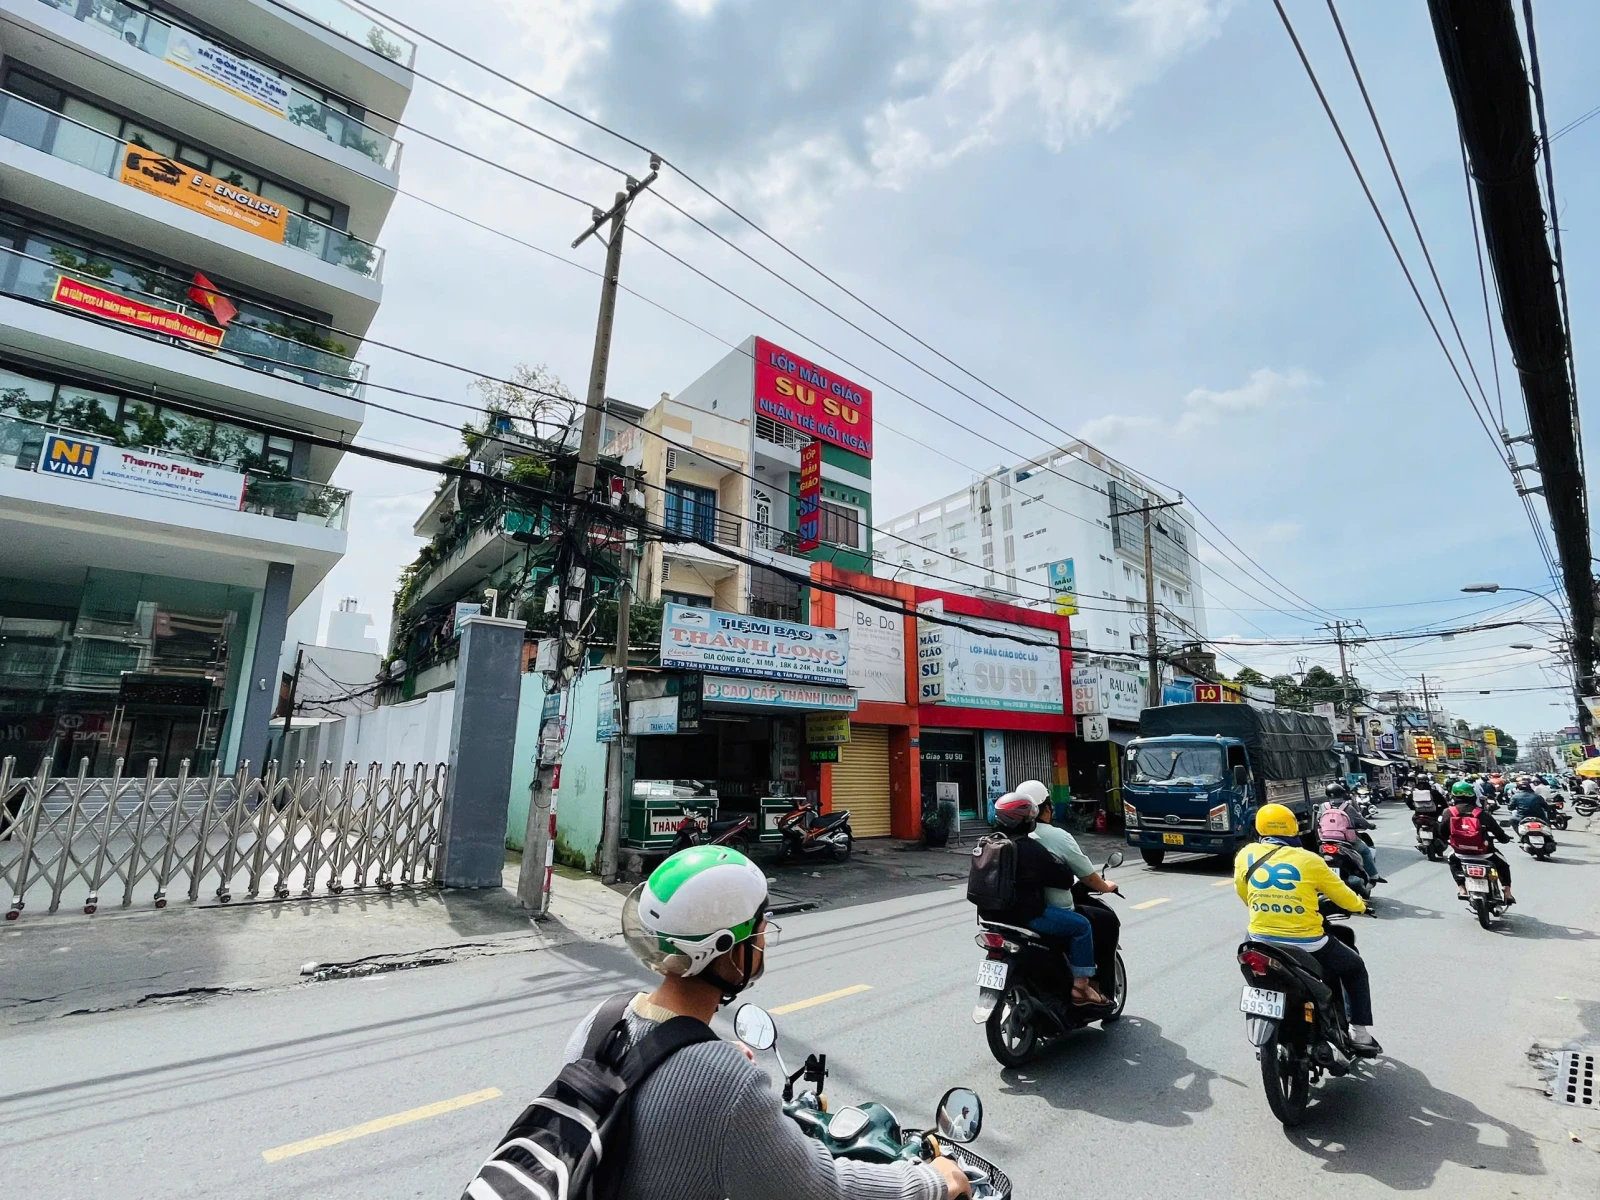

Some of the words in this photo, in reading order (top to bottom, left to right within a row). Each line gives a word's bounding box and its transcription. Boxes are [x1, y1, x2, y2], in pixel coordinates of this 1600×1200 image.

[265, 81, 288, 97] LAND
[192, 174, 203, 186] E
[214, 184, 280, 218] ENGLISH
[205, 200, 233, 216] English
[60, 286, 70, 297] AN
[771, 352, 796, 373] LỚP
[799, 365, 828, 389] MẪU
[831, 381, 862, 406] GIÁO
[775, 376, 816, 406] SU
[822, 397, 860, 425] SU
[759, 398, 794, 422] NHẬN
[796, 413, 815, 431] TRẺ
[817, 421, 840, 440] MỖI
[841, 434, 871, 453] NGÀY
[51, 439, 94, 466] Ni
[802, 448, 816, 462] LỚP
[49, 460, 89, 477] VINA
[122, 454, 168, 471] Thermo
[171, 464, 204, 478] Fisher
[102, 470, 146, 482] LABORATORY
[121, 464, 201, 485] SCIENTIFIC
[800, 475, 818, 492] GIÁO
[799, 494, 818, 516] SU
[799, 520, 818, 542] SU
[1055, 577, 1072, 586] MẪU
[718, 616, 770, 634] TIỆM
[774, 626, 813, 640] BẠC
[856, 611, 872, 627] Be
[880, 616, 895, 631] Do
[669, 627, 770, 653] THÀNH
[777, 643, 841, 663] LONG
[920, 632, 940, 646] MẪU
[717, 654, 735, 662] CÔNG
[919, 646, 941, 658] GIÁO
[969, 644, 982, 654] LỚP
[983, 644, 997, 656] MẪU
[998, 648, 1014, 659] GIÁO
[921, 662, 940, 677] SU
[974, 662, 1005, 692] SU
[1009, 666, 1038, 695] SU
[1110, 677, 1124, 692] RAU
[1127, 680, 1138, 695] MÁ
[682, 691, 697, 702] CAO
[722, 685, 750, 699] CAO
[751, 683, 779, 700] CẤP
[781, 688, 821, 704] THÀNH
[823, 693, 854, 706] LONG
[922, 683, 941, 698] SU
[1075, 687, 1094, 700] SU
[1200, 687, 1216, 699] LÒ
[681, 704, 697, 719] CẤP
[1076, 701, 1095, 713] SU
[988, 754, 1001, 764] CHÀO
[992, 766, 998, 775] BÉ
[991, 776, 1001, 787] ĐẾN
[1248, 853, 1301, 890] be
[1248, 987, 1278, 1003] 43-C1
[1242, 999, 1282, 1017] 595.30
